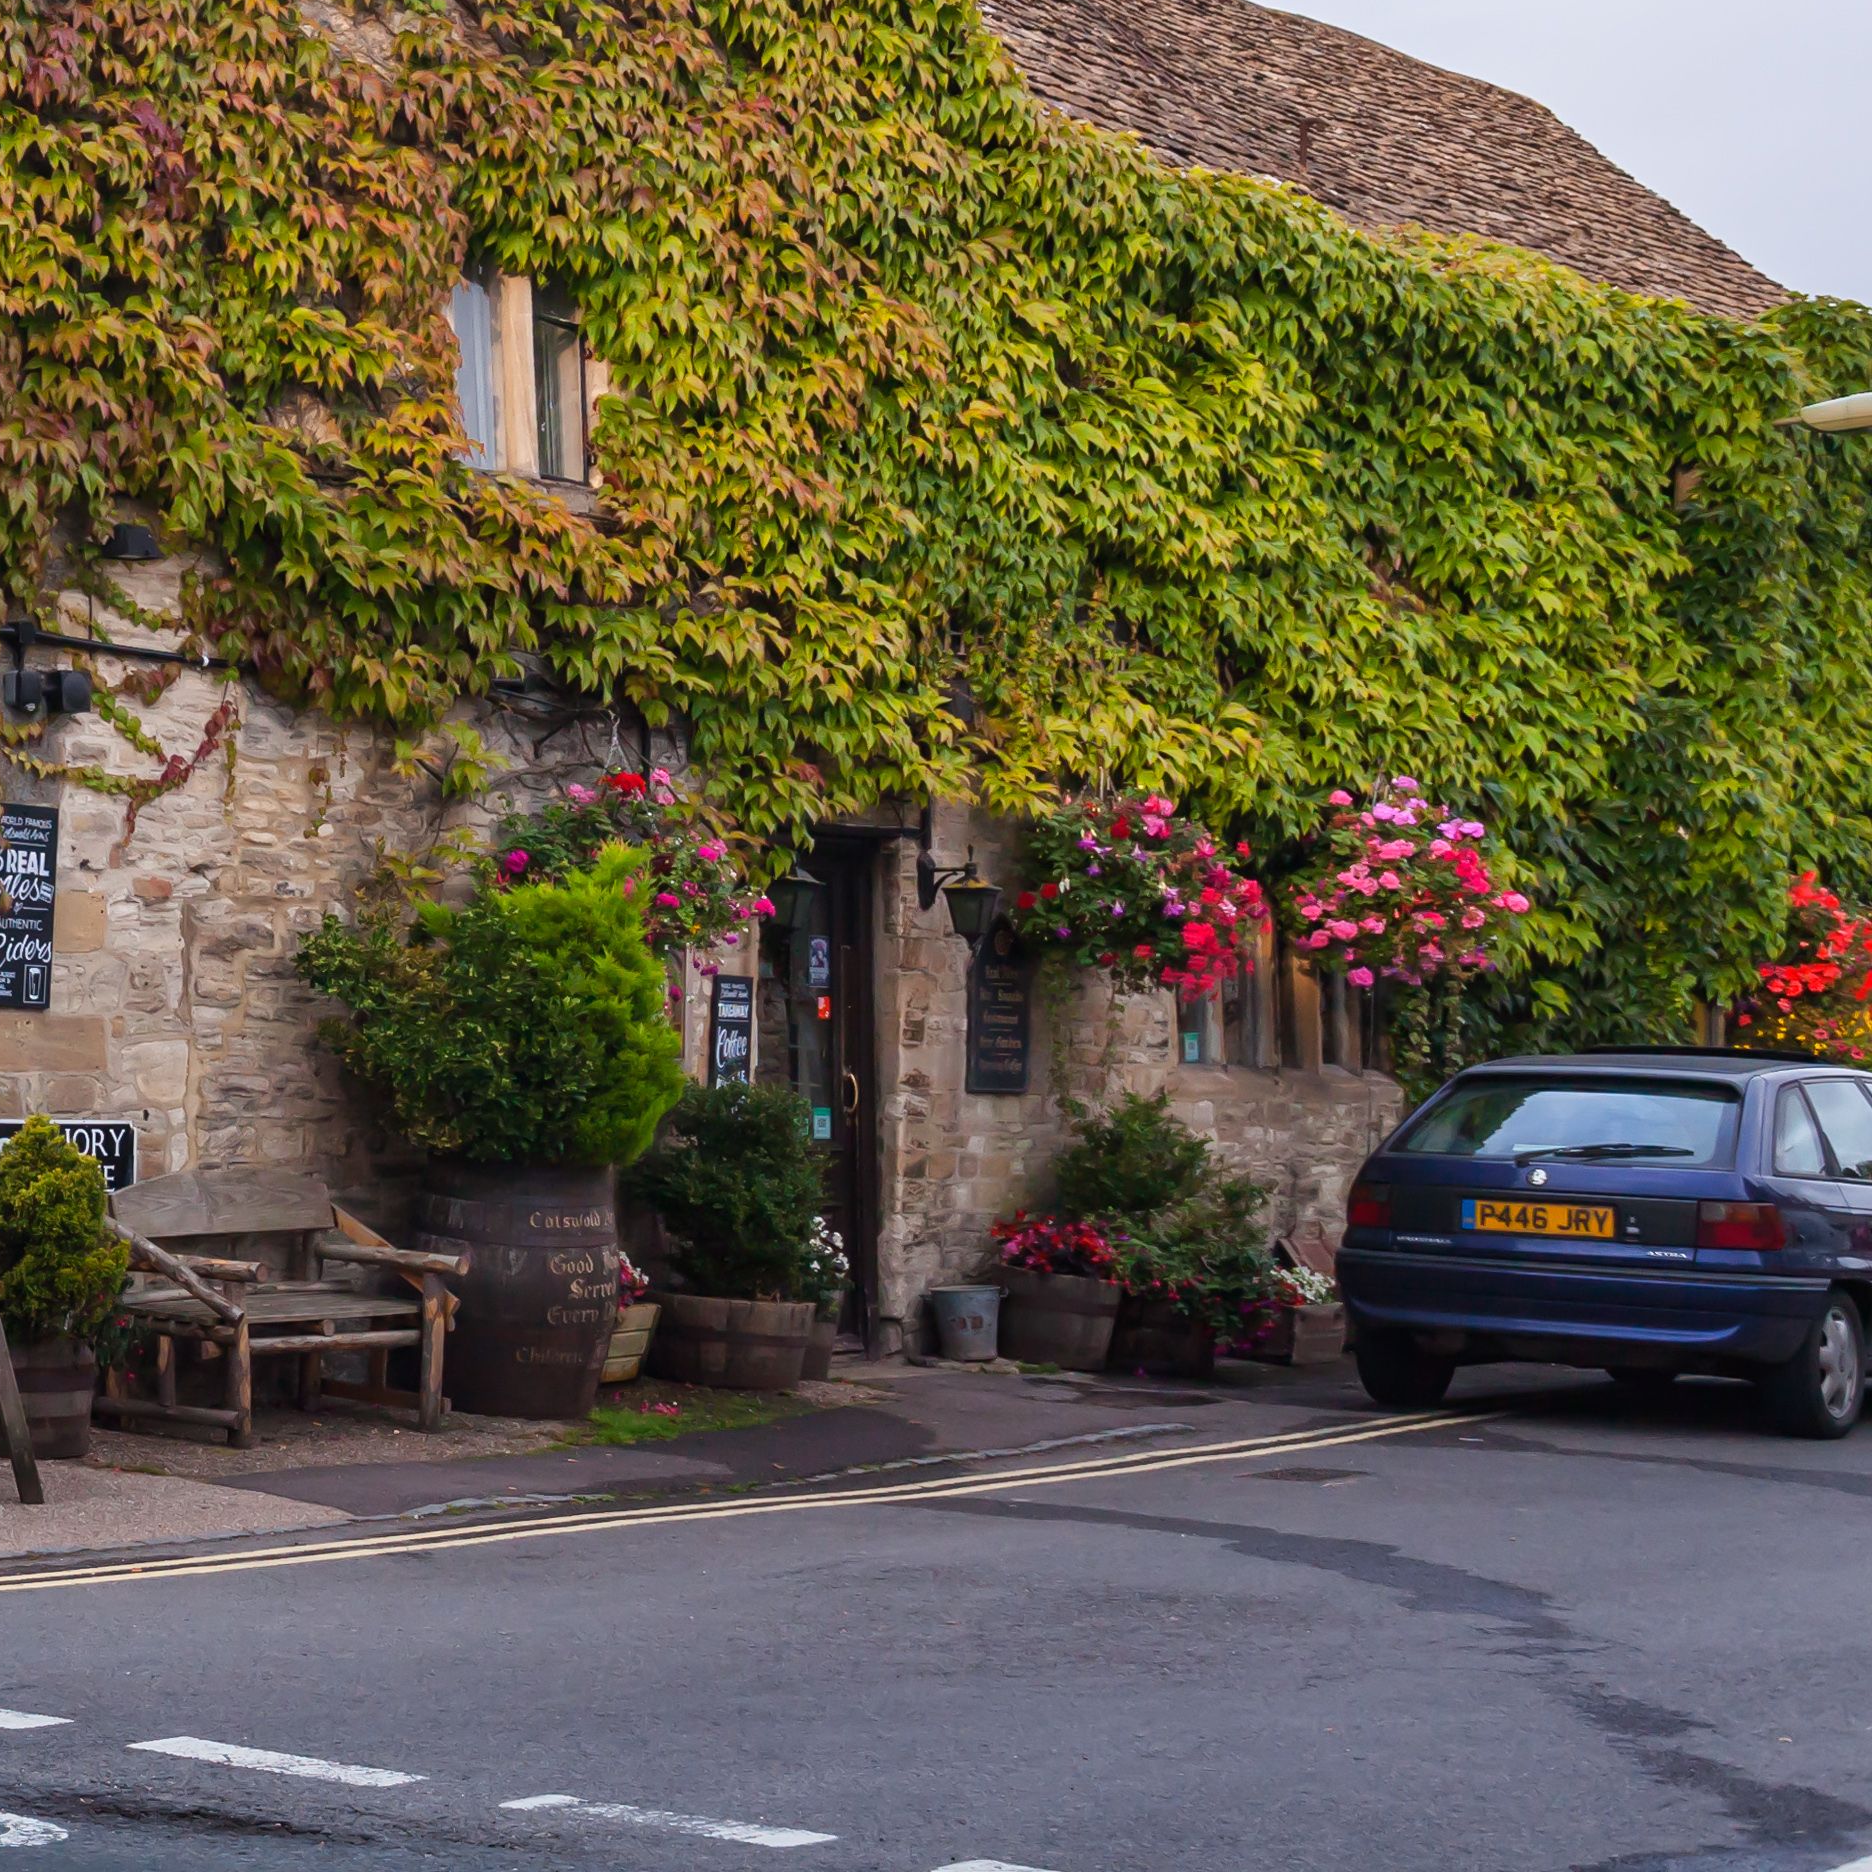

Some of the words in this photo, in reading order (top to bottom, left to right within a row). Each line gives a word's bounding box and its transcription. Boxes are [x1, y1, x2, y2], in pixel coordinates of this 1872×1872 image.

[25, 817, 53, 829] FAMOUS
[6, 849, 50, 877] REAL
[716, 1026, 748, 1069] Coffee
[529, 1211, 601, 1229] Cotswold
[1479, 1203, 1548, 1230] P446
[1557, 1207, 1609, 1234] JRY
[549, 1251, 594, 1276] Good
